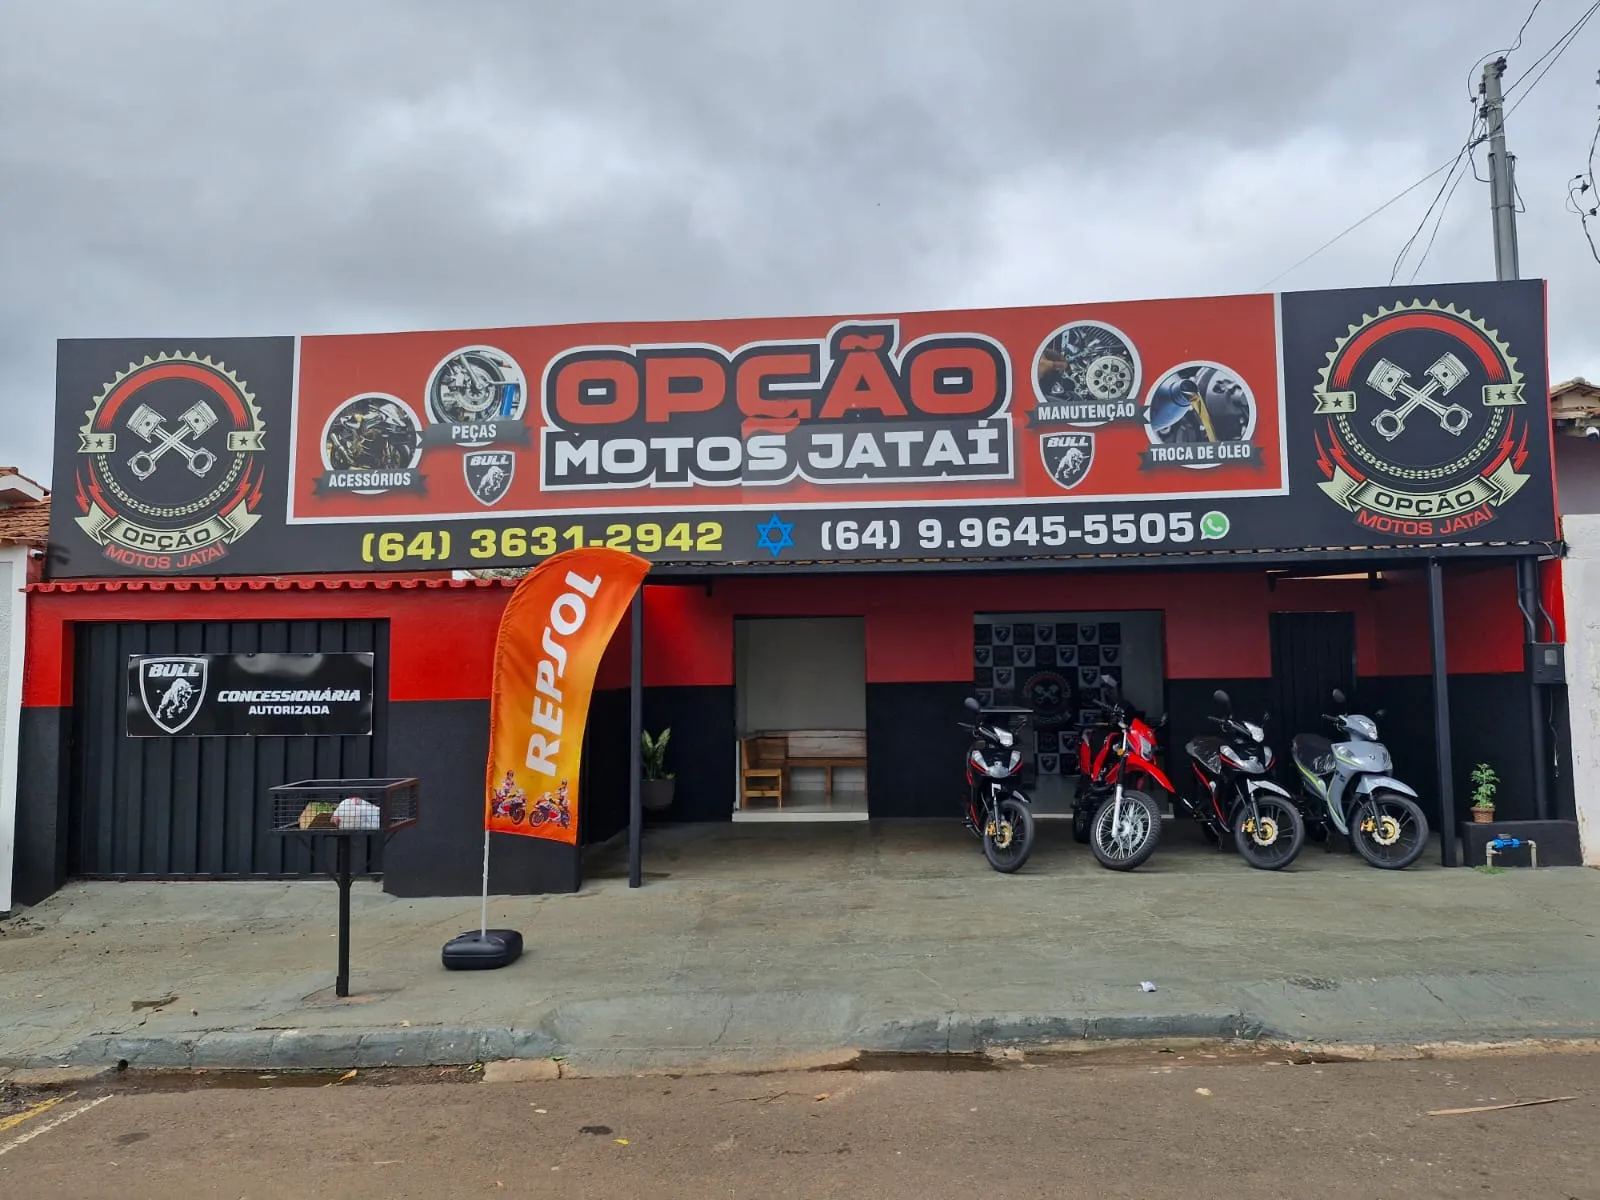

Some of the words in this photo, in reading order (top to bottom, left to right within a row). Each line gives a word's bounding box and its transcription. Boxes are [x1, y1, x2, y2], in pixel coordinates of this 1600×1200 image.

[556, 334, 998, 438] OPÇÃO
[1038, 402, 1136, 422] MANUTENÇÃO
[452, 423, 497, 443] PEÇAS
[1047, 436, 1089, 448] BULL
[555, 433, 788, 476] MOTOS
[807, 419, 999, 470] JATAÍ
[1150, 446, 1194, 462] TROCA
[1197, 446, 1215, 460] DE
[1218, 439, 1251, 459] ÓLEO
[470, 454, 510, 467] BULL
[328, 470, 412, 488] ACESSÓRIOS
[1374, 490, 1475, 516] OPÇÃO
[821, 519, 900, 551] (64)
[918, 511, 1194, 549] 9.9645-5505
[1357, 509, 1434, 536] MOTOS
[122, 526, 211, 551] OPÇÃO
[362, 531, 451, 563] (64)
[470, 521, 723, 559] 3631-2942
[106, 543, 171, 569] MOTOS
[148, 663, 200, 677] BULL
[525, 571, 602, 777] REPSOL
[217, 687, 361, 702] CONCESSIONÁRIA
[248, 705, 330, 715] AUTORIZADA
